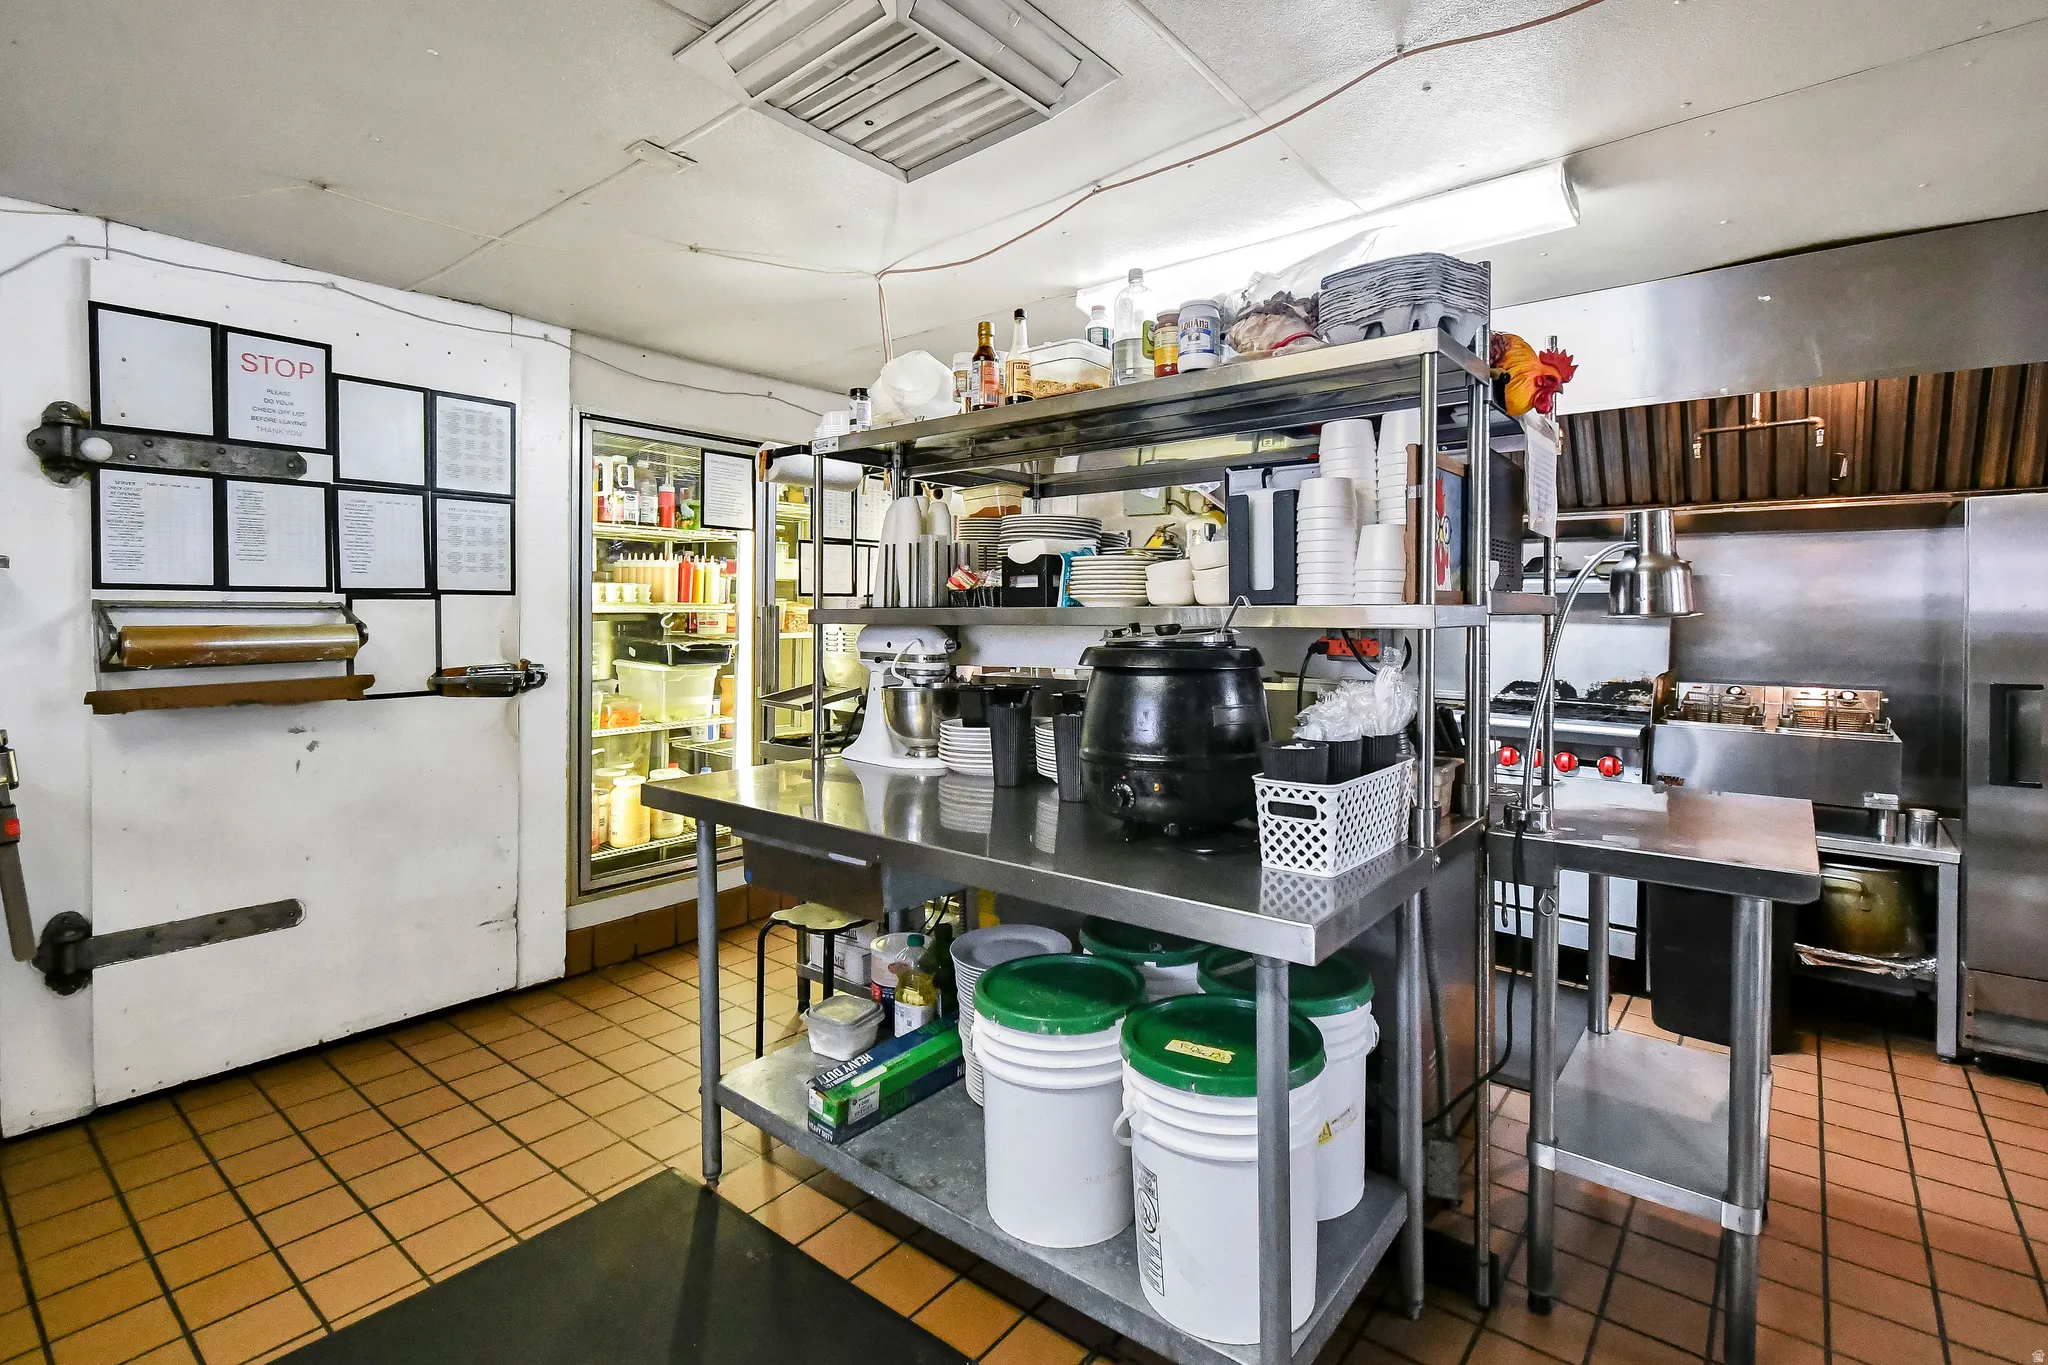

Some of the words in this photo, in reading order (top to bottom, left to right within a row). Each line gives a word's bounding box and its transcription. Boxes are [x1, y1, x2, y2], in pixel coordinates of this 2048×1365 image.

[240, 352, 315, 380] STOP
[266, 388, 291, 397] PLEASE
[263, 397, 275, 405] DO
[275, 399, 294, 407] YOUR
[251, 405, 277, 415] CHECK
[250, 415, 278, 424] BEFORE
[278, 419, 307, 428] LEAVING
[255, 425, 283, 435] THANK
[284, 429, 303, 438] YOU
[842, 1053, 874, 1075] HEAVY
[816, 1066, 844, 1086] DUTY
[821, 1129, 834, 1143] DUTY
